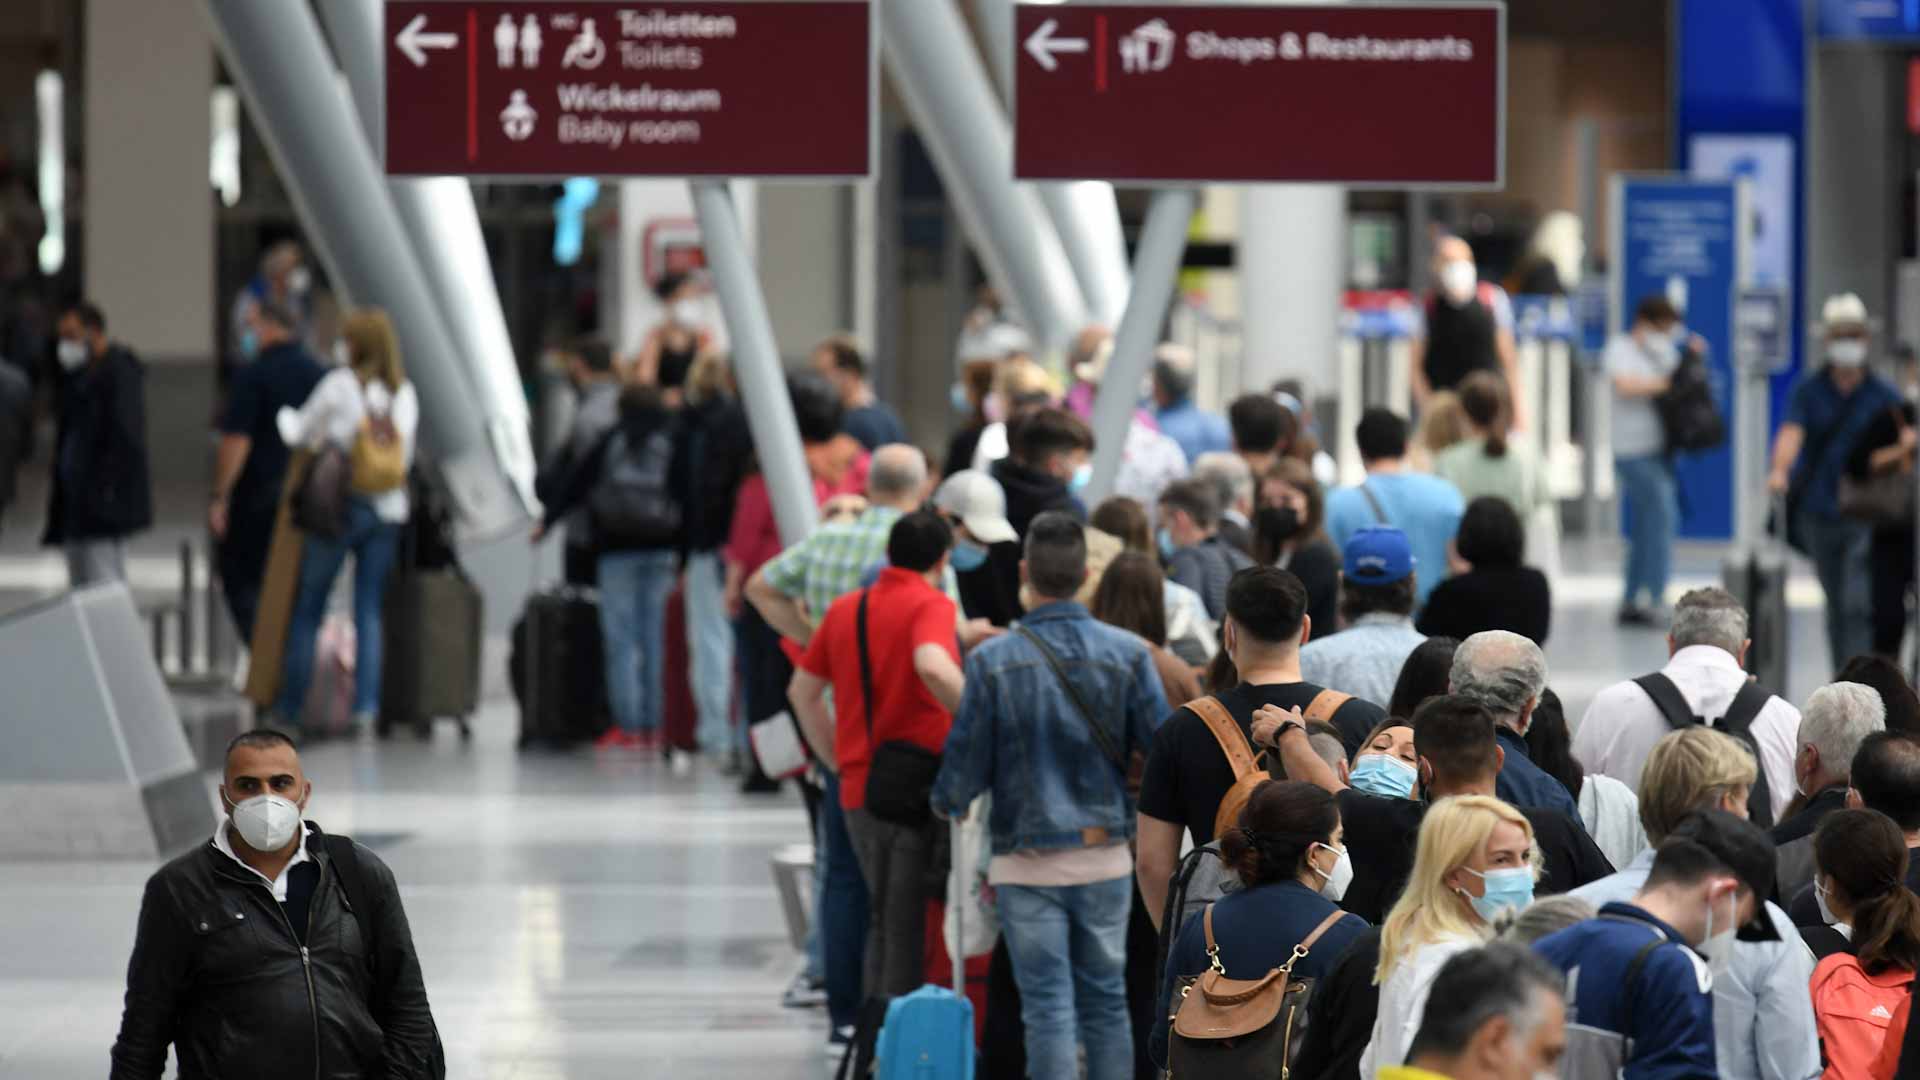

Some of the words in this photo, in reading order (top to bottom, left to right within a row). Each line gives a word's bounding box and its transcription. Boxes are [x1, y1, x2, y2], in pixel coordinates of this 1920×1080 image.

[617, 10, 736, 37] Toiletten
[617, 41, 702, 69] Toilets
[1186, 31, 1275, 64] Shops
[1278, 31, 1302, 60] &
[1306, 32, 1473, 61] Restaurants
[557, 82, 721, 112] Wickelraum
[558, 114, 626, 149] Baby
[629, 120, 700, 143] room
